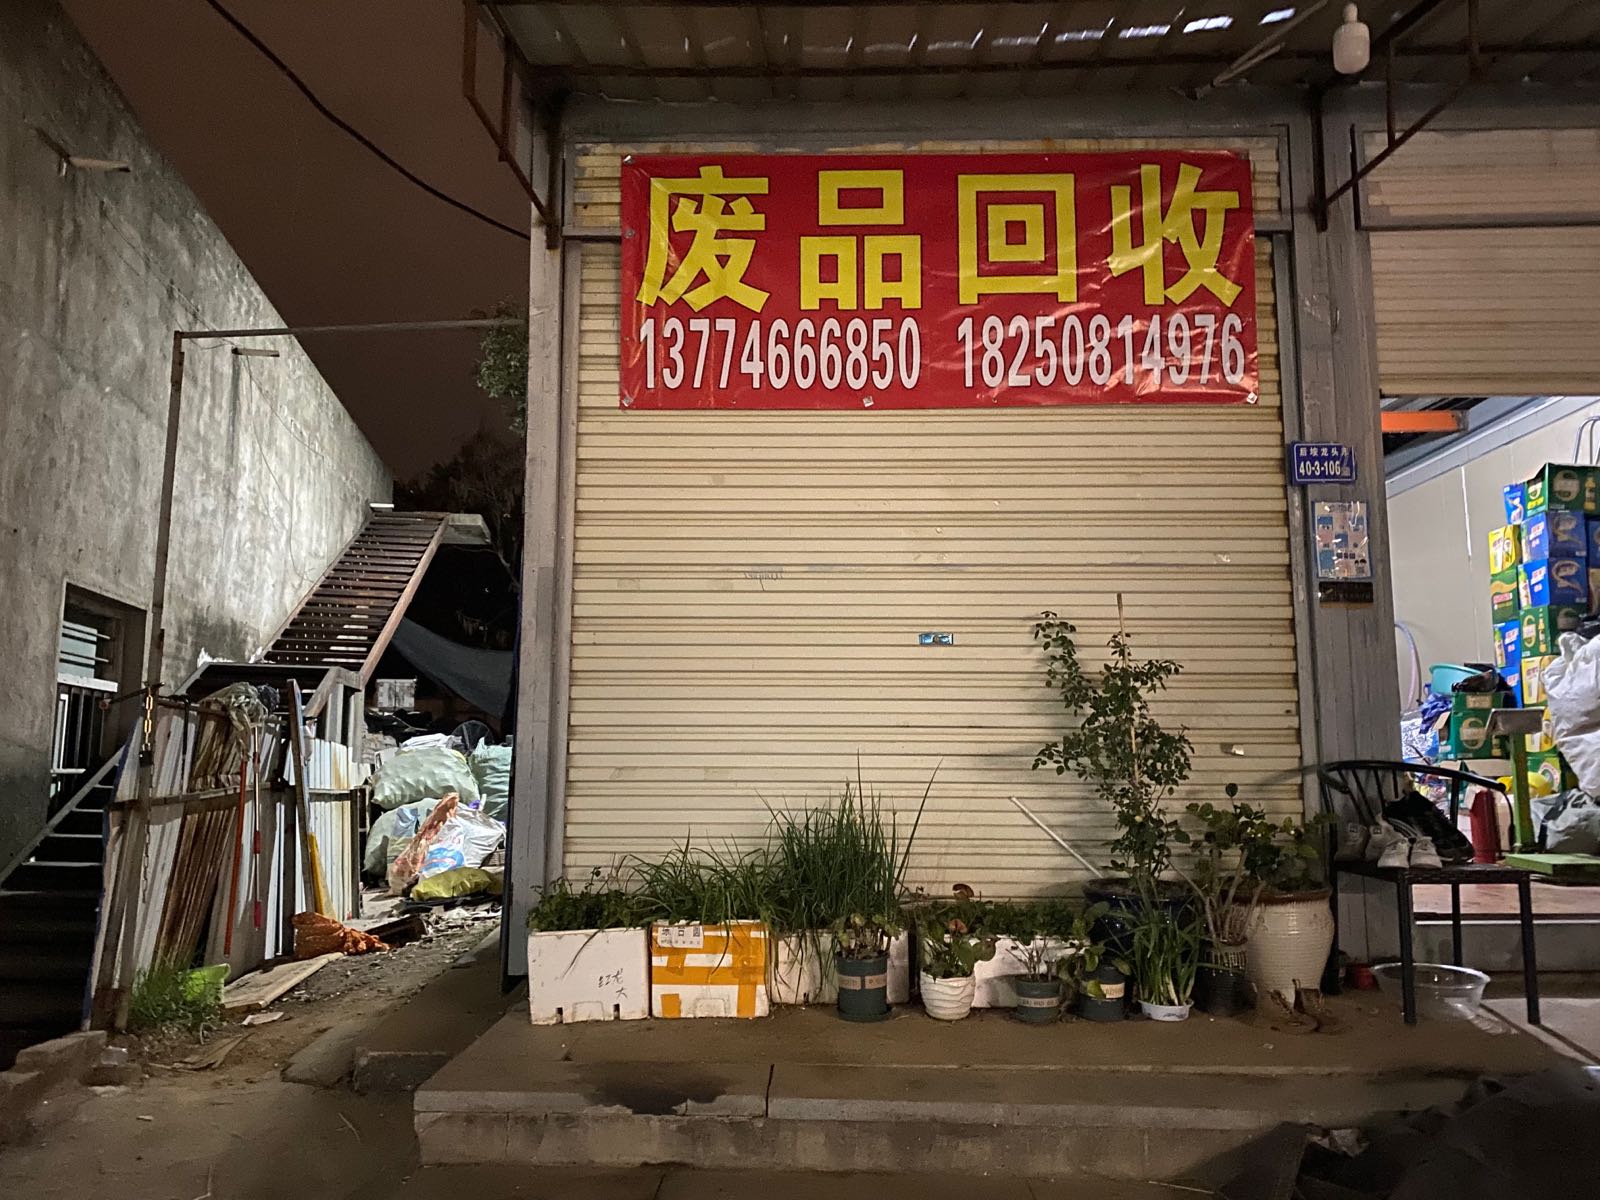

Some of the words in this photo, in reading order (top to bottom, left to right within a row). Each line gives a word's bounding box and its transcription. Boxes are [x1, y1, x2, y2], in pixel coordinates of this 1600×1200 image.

[635, 162, 1244, 313] 废品回收
[639, 315, 922, 391] 13774666850
[957, 313, 1246, 389] 18250814976
[1299, 460, 1341, 476] 40-3-106
